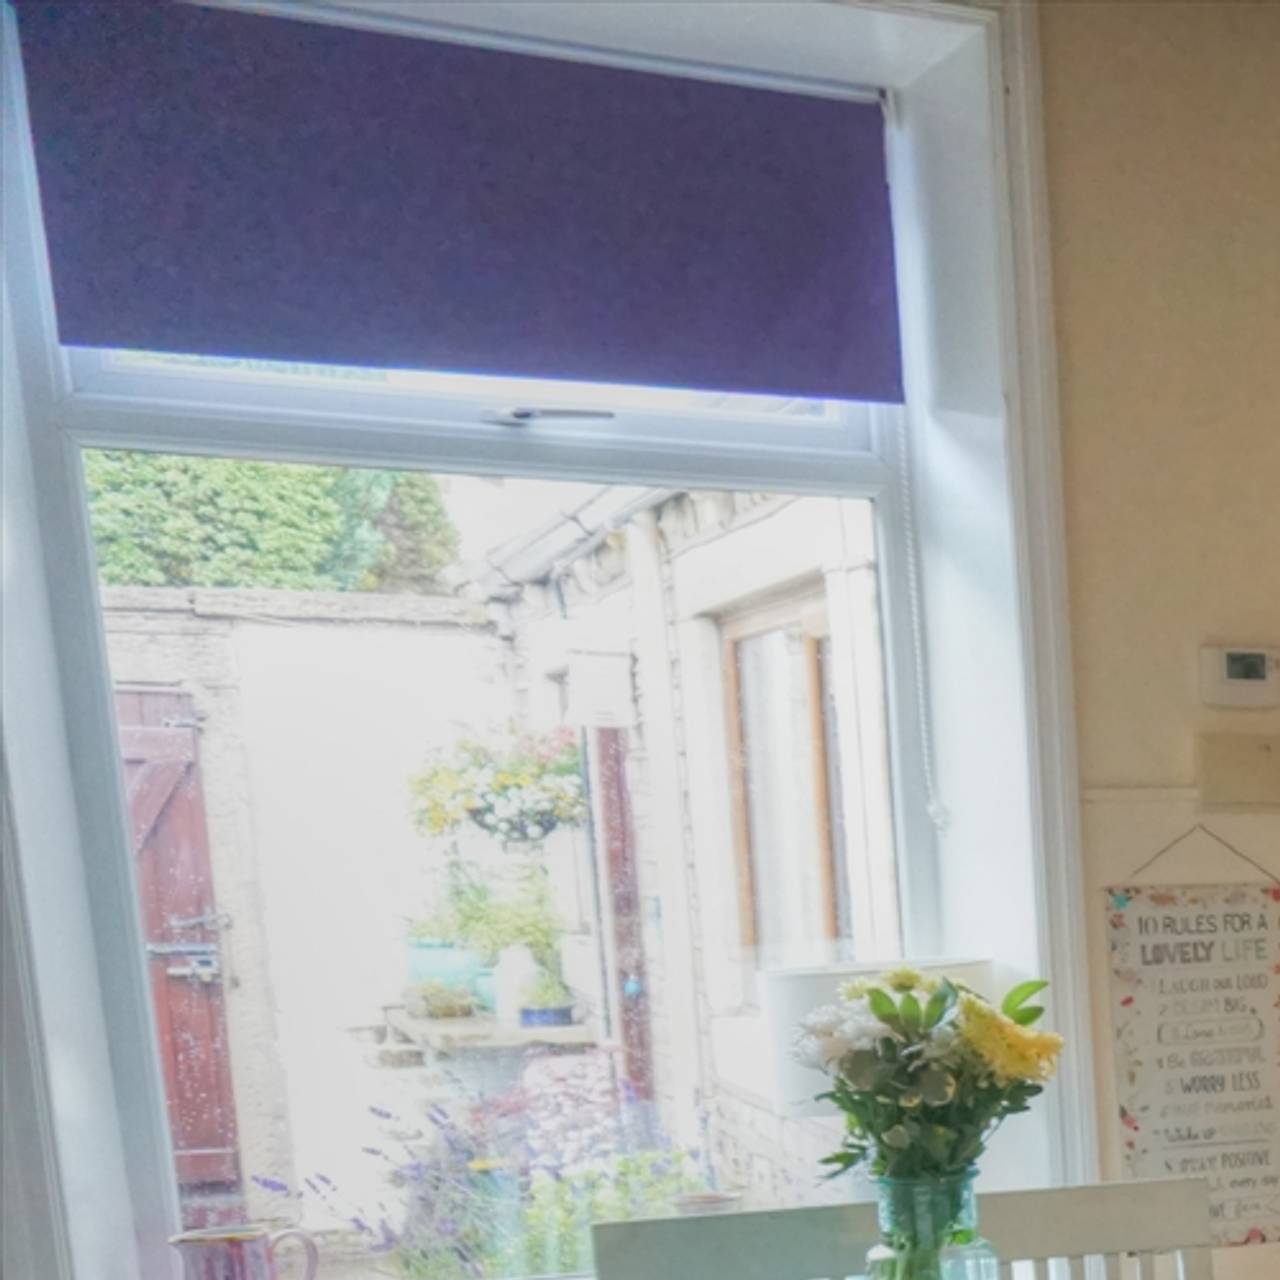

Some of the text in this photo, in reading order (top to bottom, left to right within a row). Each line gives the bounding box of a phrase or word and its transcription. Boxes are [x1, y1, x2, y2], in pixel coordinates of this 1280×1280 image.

[1138, 912, 1269, 936] 10 RULES FOR A
[1140, 937, 1268, 966] LOVELY LIFE
[1179, 1072, 1226, 1095] WORRY
[1230, 1070, 1262, 1092] LESS
